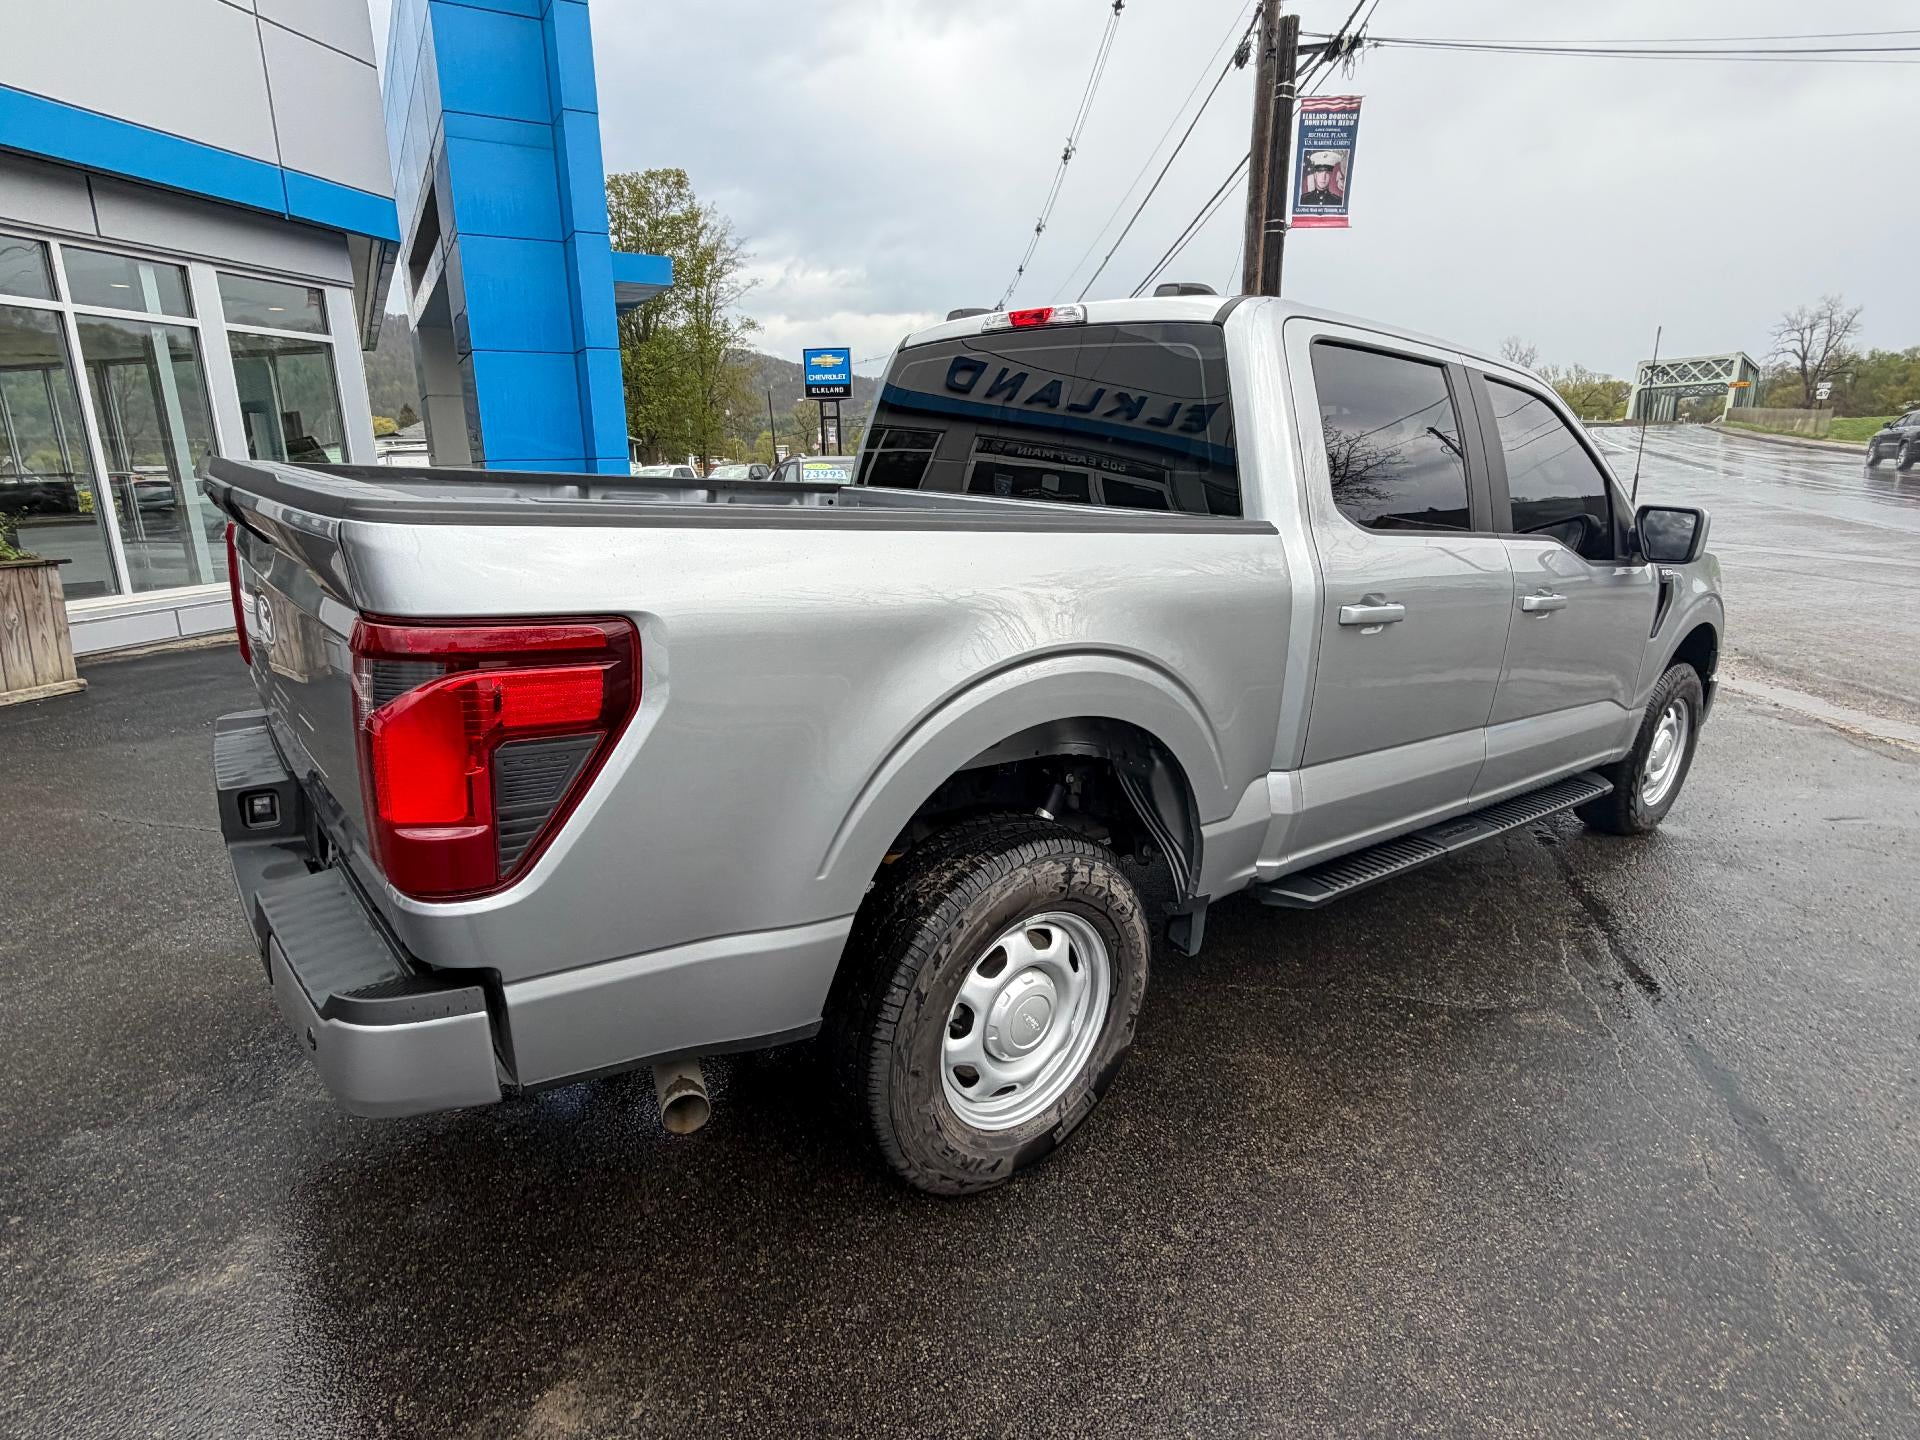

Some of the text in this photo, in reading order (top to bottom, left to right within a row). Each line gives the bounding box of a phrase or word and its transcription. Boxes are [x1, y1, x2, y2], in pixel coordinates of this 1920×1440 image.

[808, 373, 846, 381] CHEVROLET
[811, 386, 844, 394] ELKLAND
[805, 470, 844, 478] 23995
